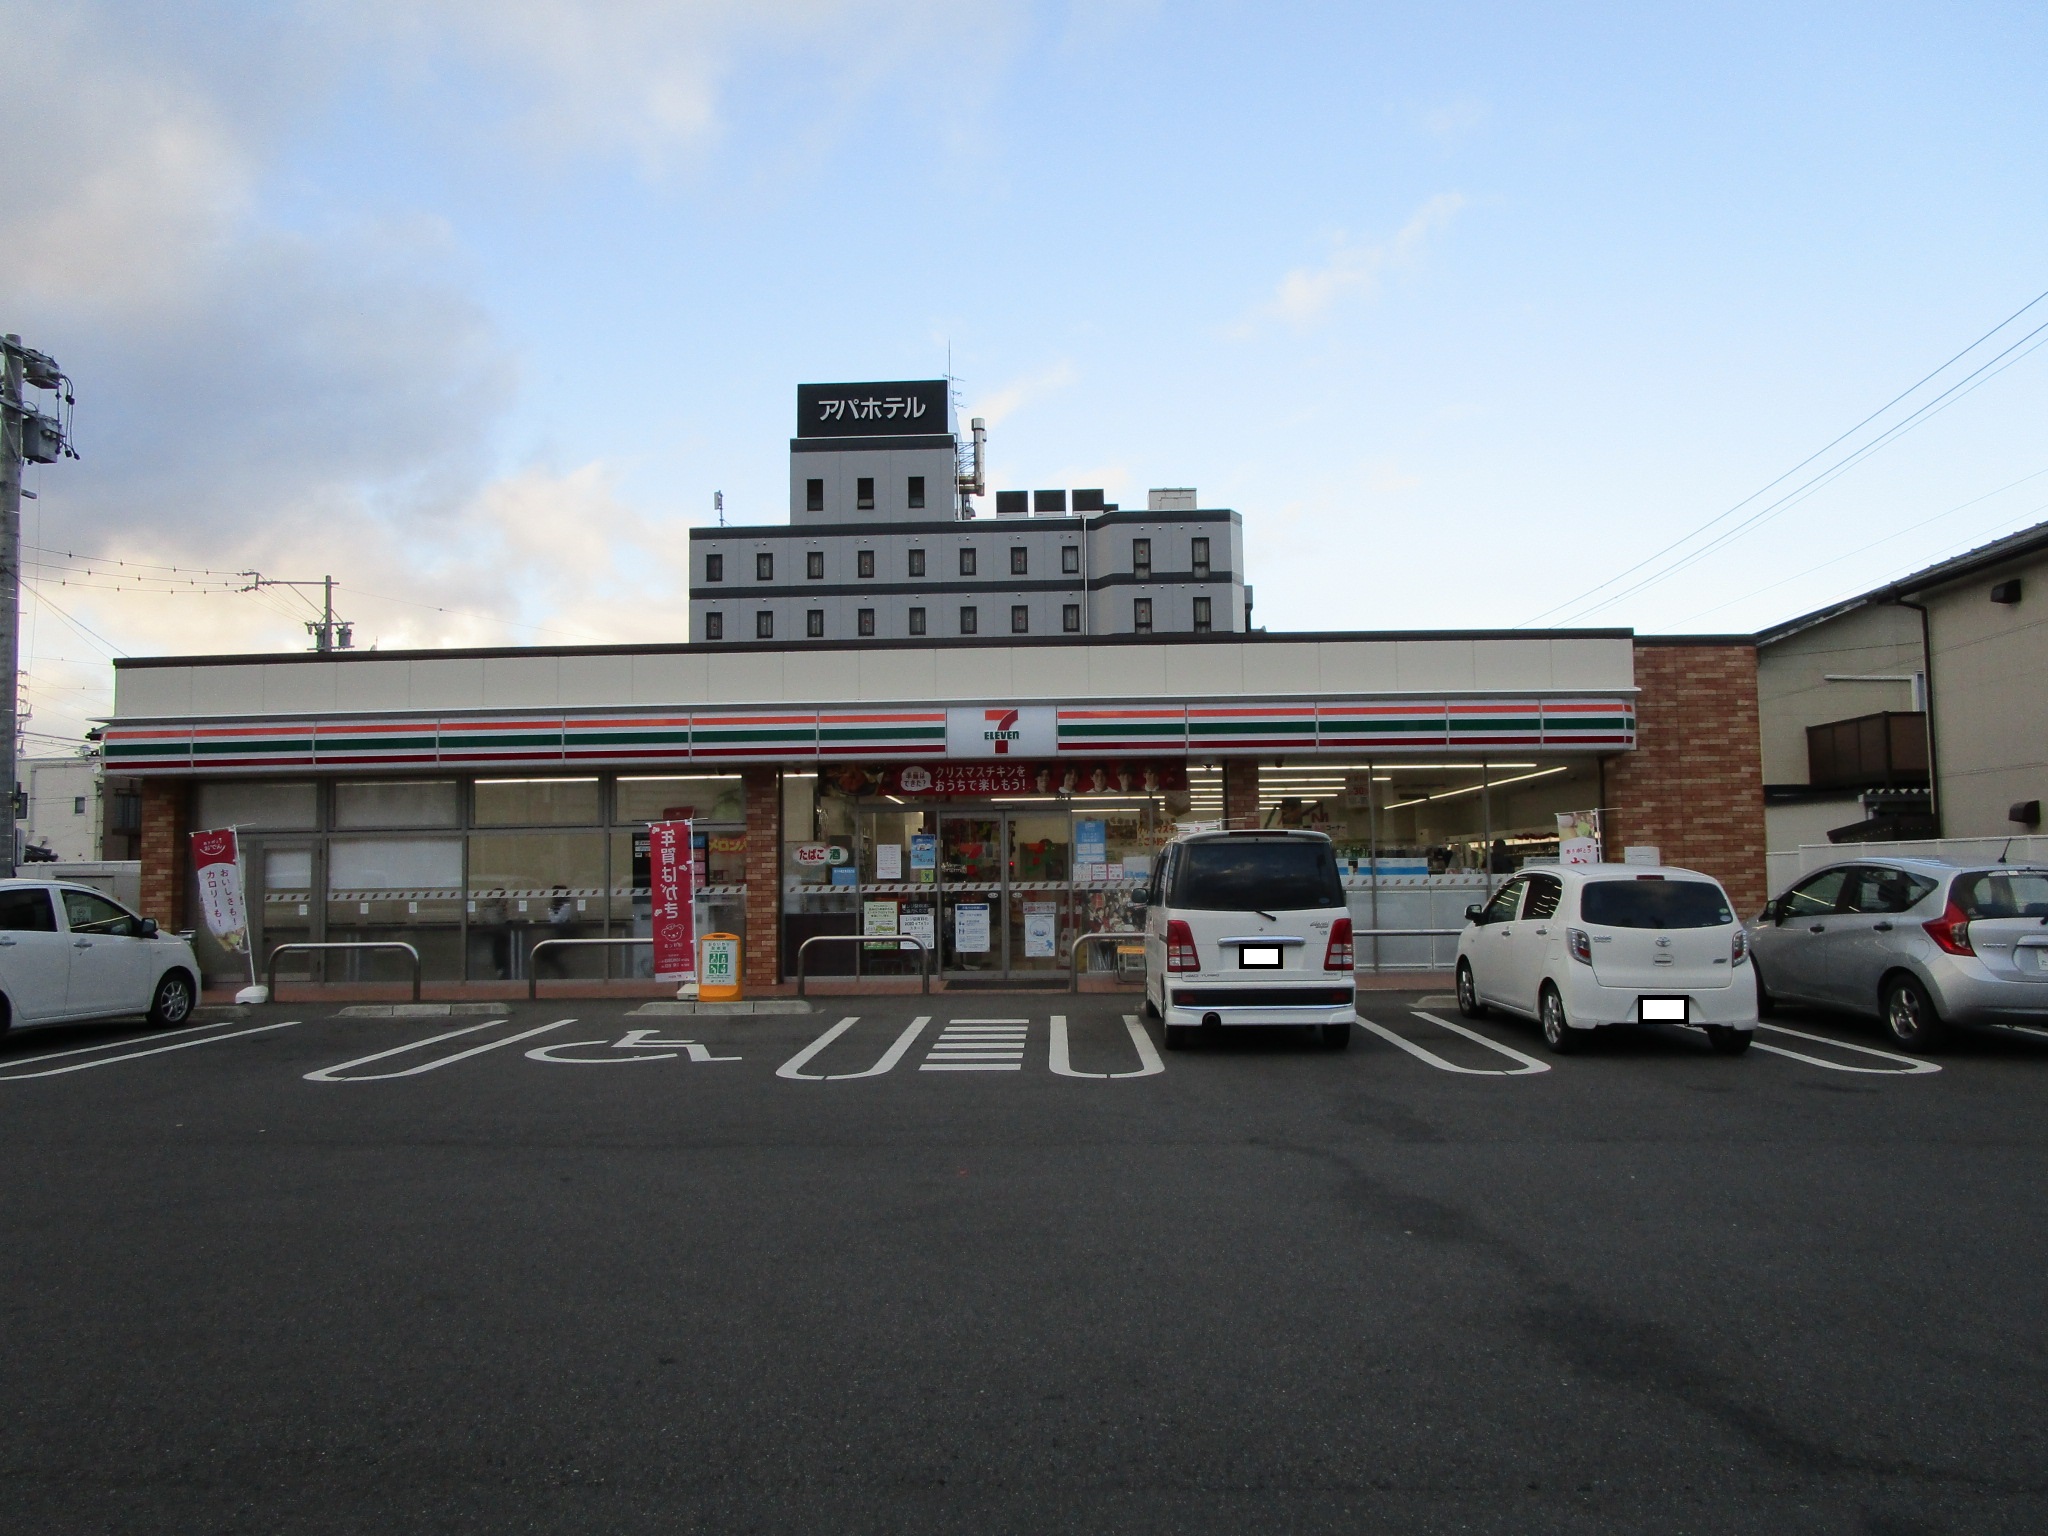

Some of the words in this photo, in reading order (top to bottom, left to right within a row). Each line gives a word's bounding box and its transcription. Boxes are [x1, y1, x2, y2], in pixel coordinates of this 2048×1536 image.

[817, 395, 927, 422] アパホテル
[935, 765, 1027, 778] クリスマスチキンを
[935, 778, 1027, 792] おうちで楽しもう！
[799, 848, 825, 861] たばこ
[828, 848, 841, 860] 酒
[207, 870, 222, 926] カロリーも！
[220, 868, 237, 926] おいしさも！
